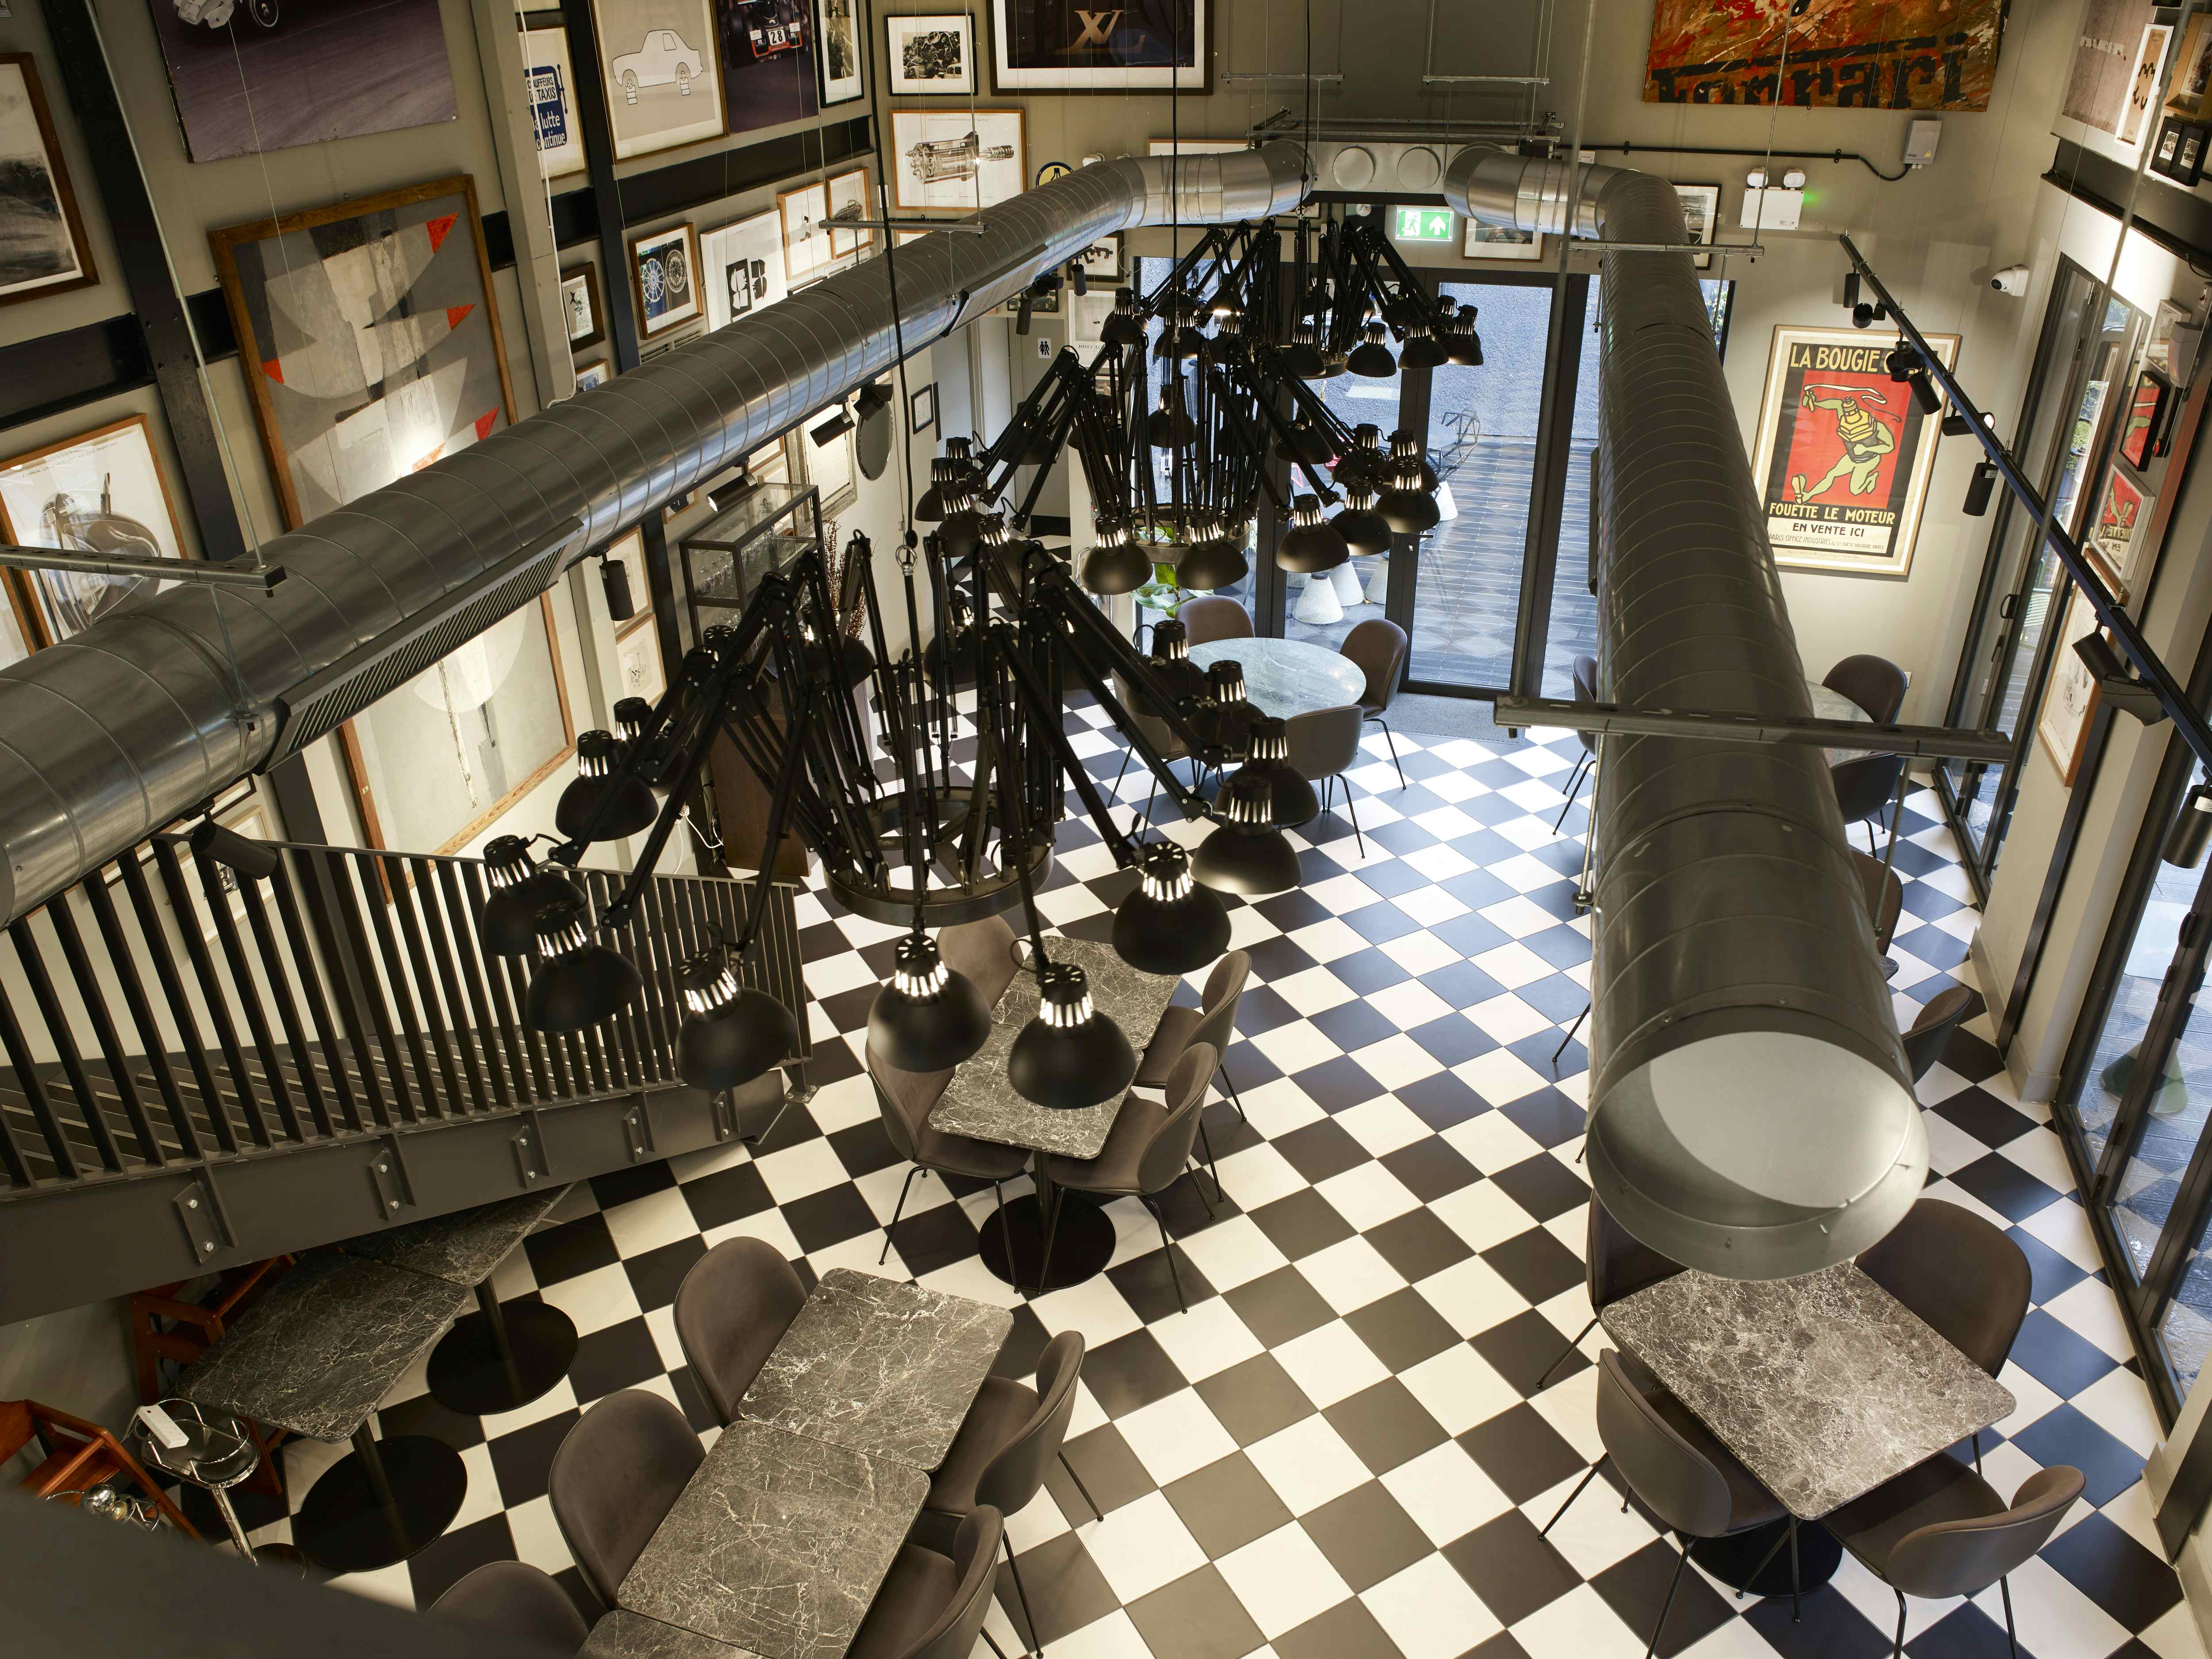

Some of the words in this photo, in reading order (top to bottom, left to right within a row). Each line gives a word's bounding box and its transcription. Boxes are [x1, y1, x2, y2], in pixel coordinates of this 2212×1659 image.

[770, 30, 783, 44] 28
[527, 77, 554, 89] CAUFFEURS
[537, 87, 556, 101] TAXIS
[540, 111, 561, 130] lutte
[536, 131, 566, 150] cntinue
[1790, 345, 1811, 369] LA
[1816, 347, 1881, 372] BOUGIE
[1769, 502, 1818, 519] FOUETTE
[1824, 507, 1839, 521] LE
[1845, 509, 1896, 525] MOTEUR
[1792, 522, 1807, 532] EN
[1811, 524, 1846, 535] VENTE
[1850, 528, 1865, 537] ICI
[1803, 537, 1832, 545] INDUSTRIEL
